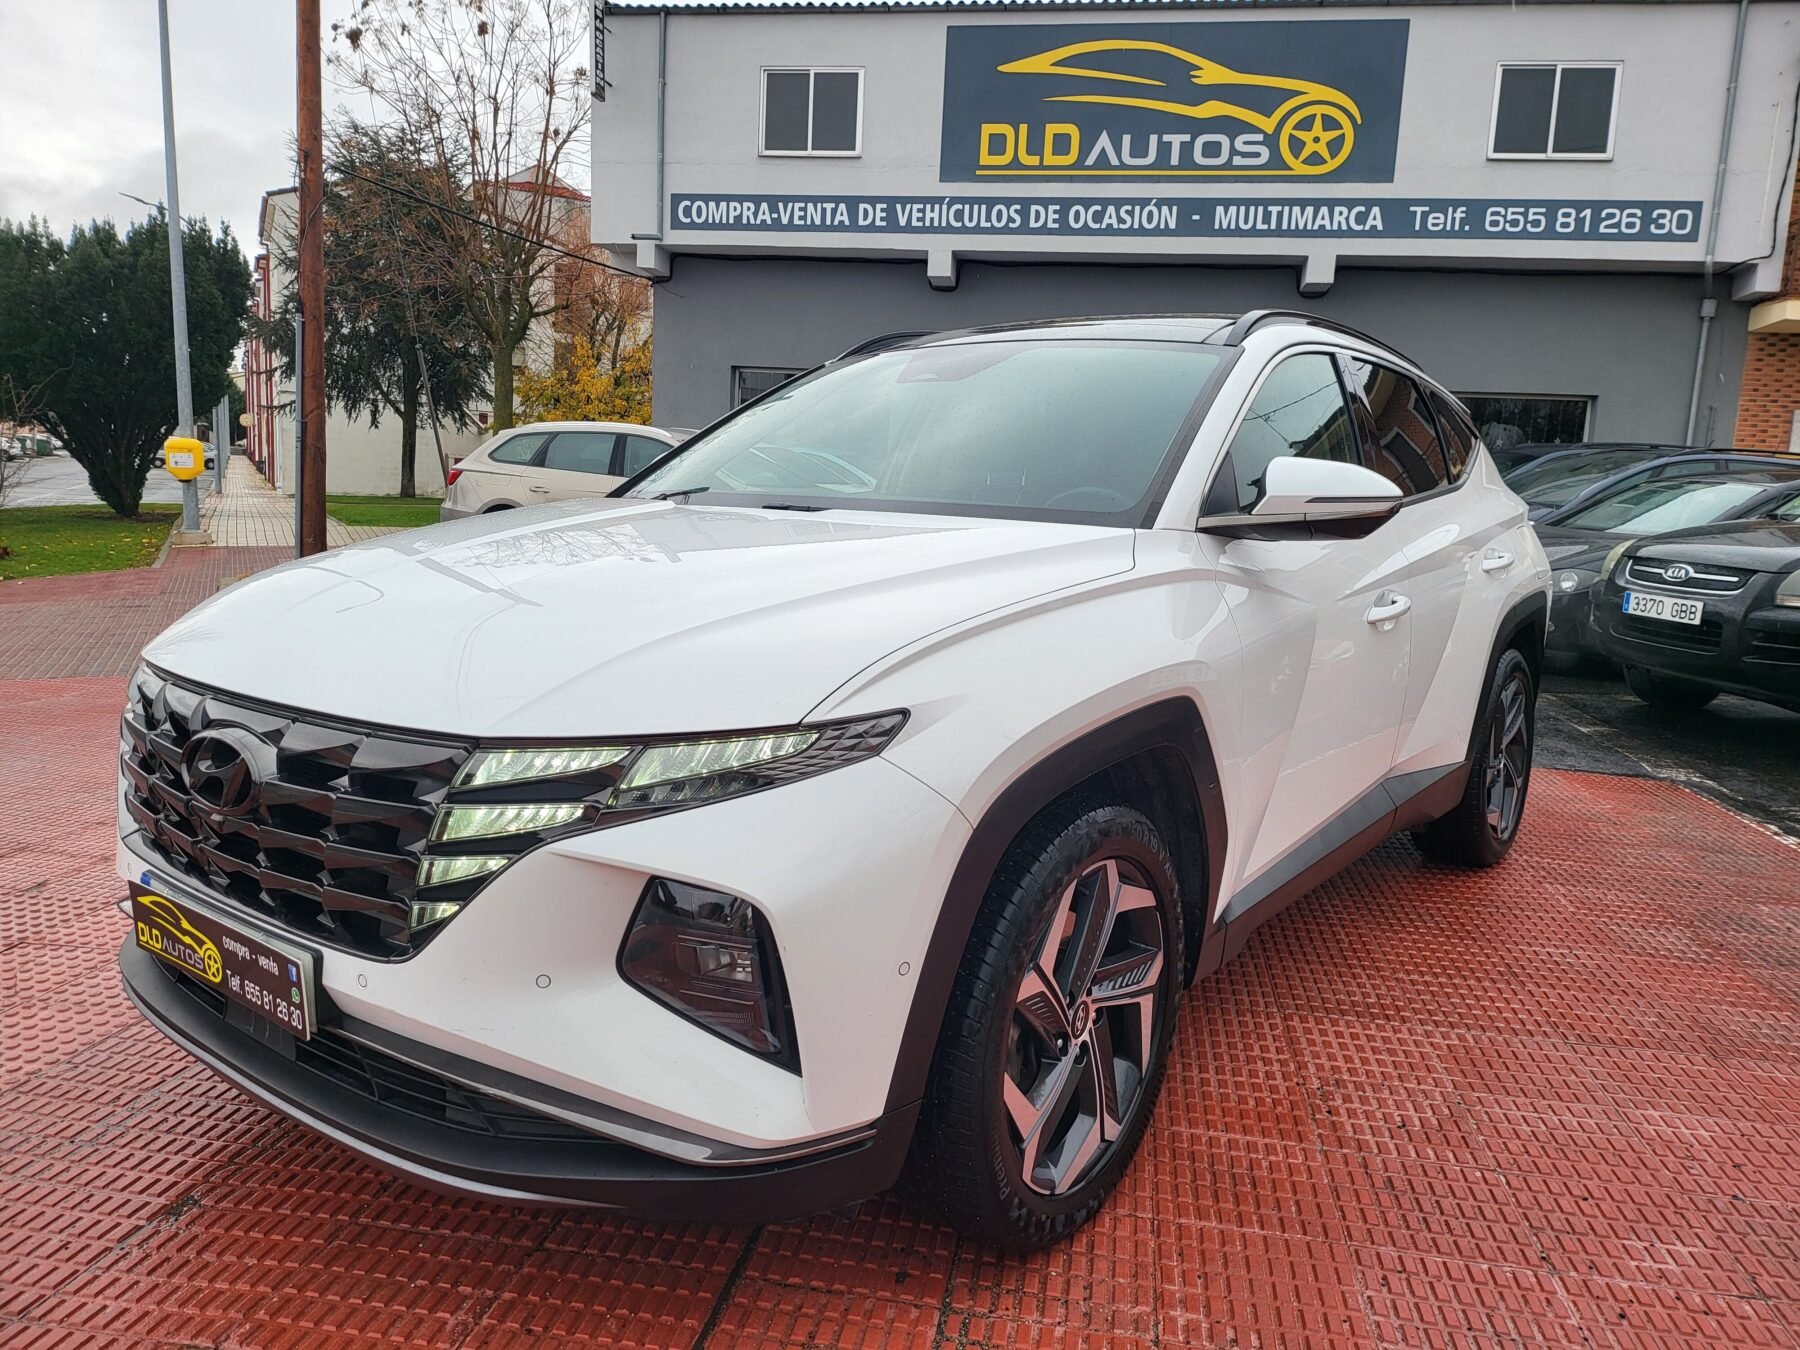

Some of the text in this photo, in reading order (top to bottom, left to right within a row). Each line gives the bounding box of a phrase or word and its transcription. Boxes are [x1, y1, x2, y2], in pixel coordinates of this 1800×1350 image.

[677, 199, 850, 227] COMPRA-VENTA
[857, 201, 887, 227] DE
[896, 197, 1022, 229] VEHÍCULOS
[1029, 203, 1060, 229] DE
[1068, 199, 1178, 230] OCASIÓN
[1213, 204, 1384, 232] MULTIMARCA
[1409, 205, 1471, 233] Telf.
[1484, 207, 1547, 234] 655
[1555, 208, 1592, 234] 81
[1600, 208, 1642, 235] 26
[1650, 209, 1694, 236] 30
[1665, 567, 1686, 579] KIA
[1632, 596, 1698, 621] 3370 GBB
[222, 935, 250, 961] compra
[257, 952, 279, 976] venta
[226, 969, 303, 1030] Telf. 655 81 26 30
